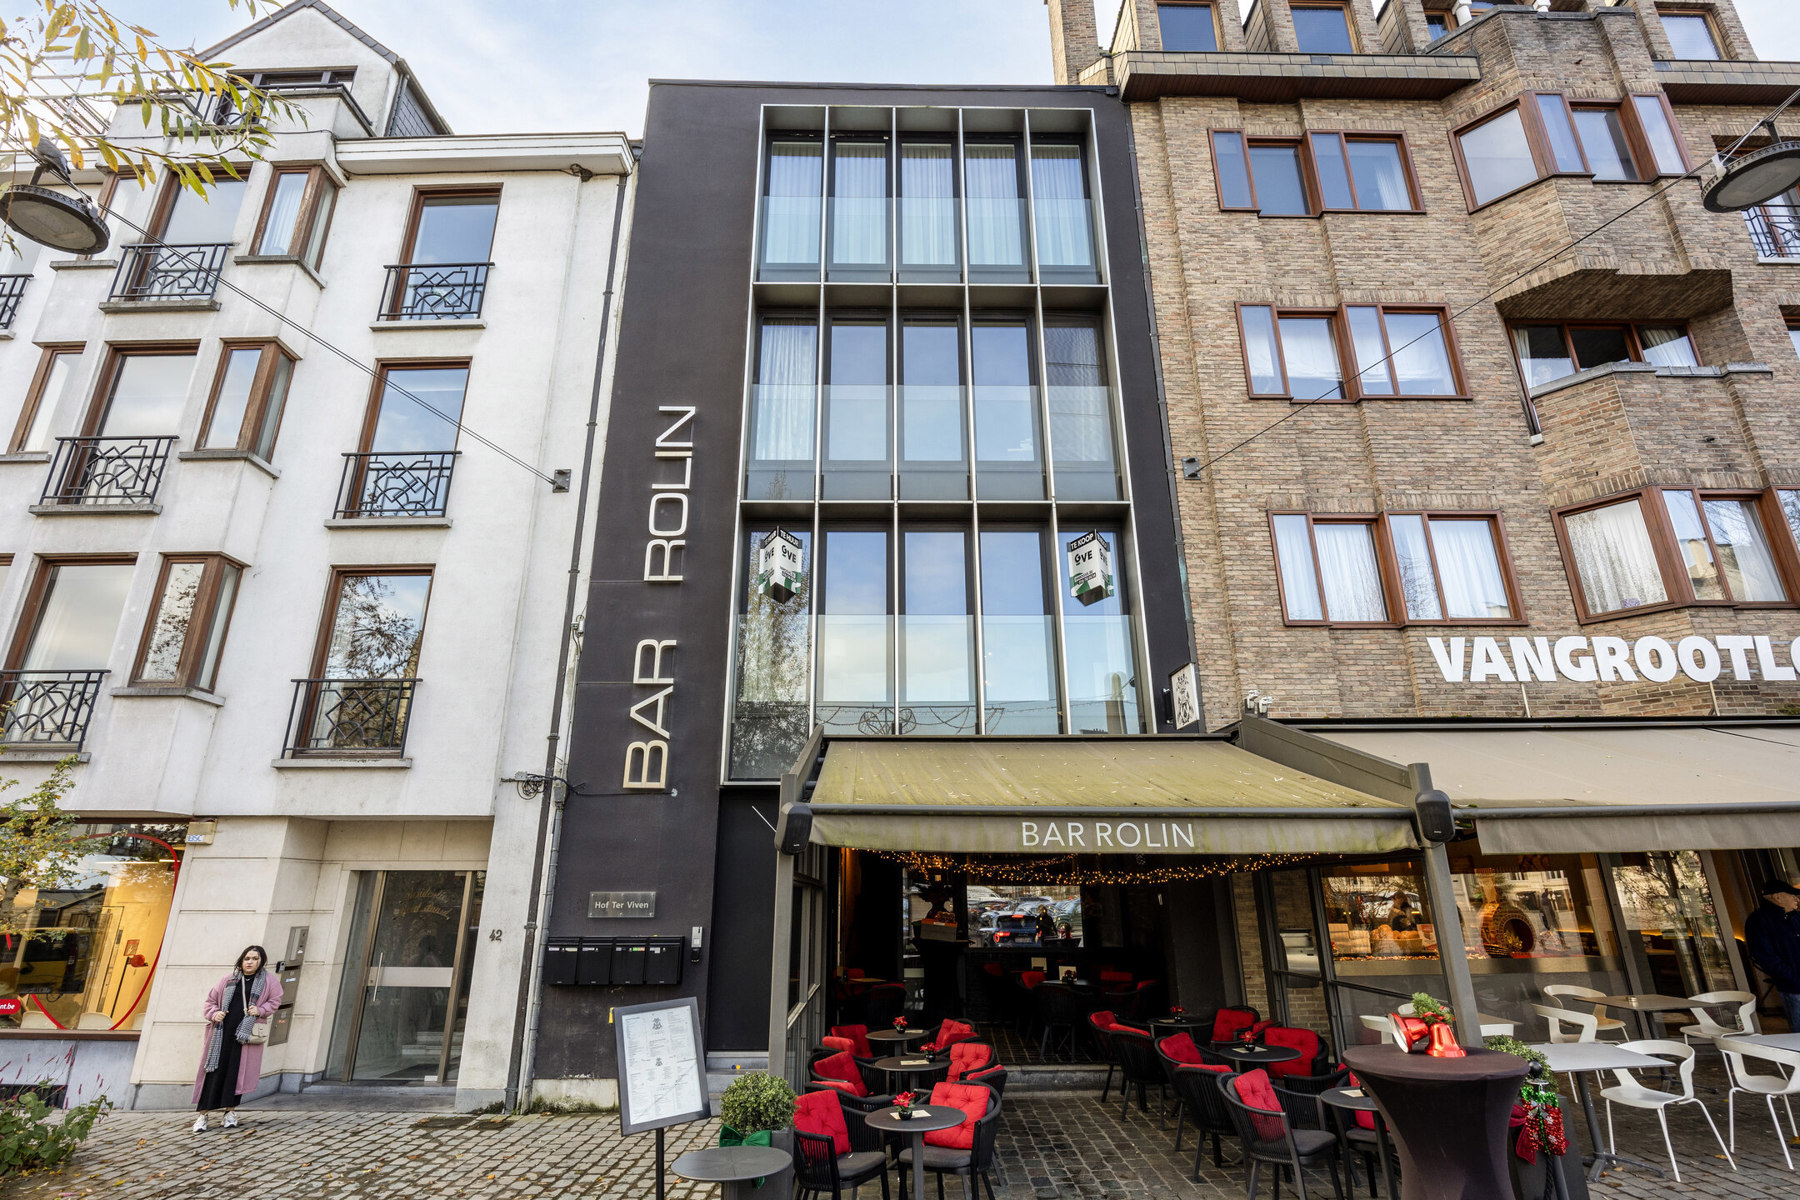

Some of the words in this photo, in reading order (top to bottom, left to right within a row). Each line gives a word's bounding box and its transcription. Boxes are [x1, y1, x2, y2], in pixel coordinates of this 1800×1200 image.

[643, 406, 696, 582] ROLIN
[1078, 533, 1094, 547] KOOP
[1426, 635, 1800, 682] VANGROOTL
[623, 639, 677, 789] BAR
[1021, 821, 1086, 847] BAR
[1095, 822, 1196, 848] ROLIN
[594, 901, 610, 909] Hof
[612, 901, 625, 909] Ter
[627, 901, 649, 909] Viven
[489, 929, 503, 942] 42
